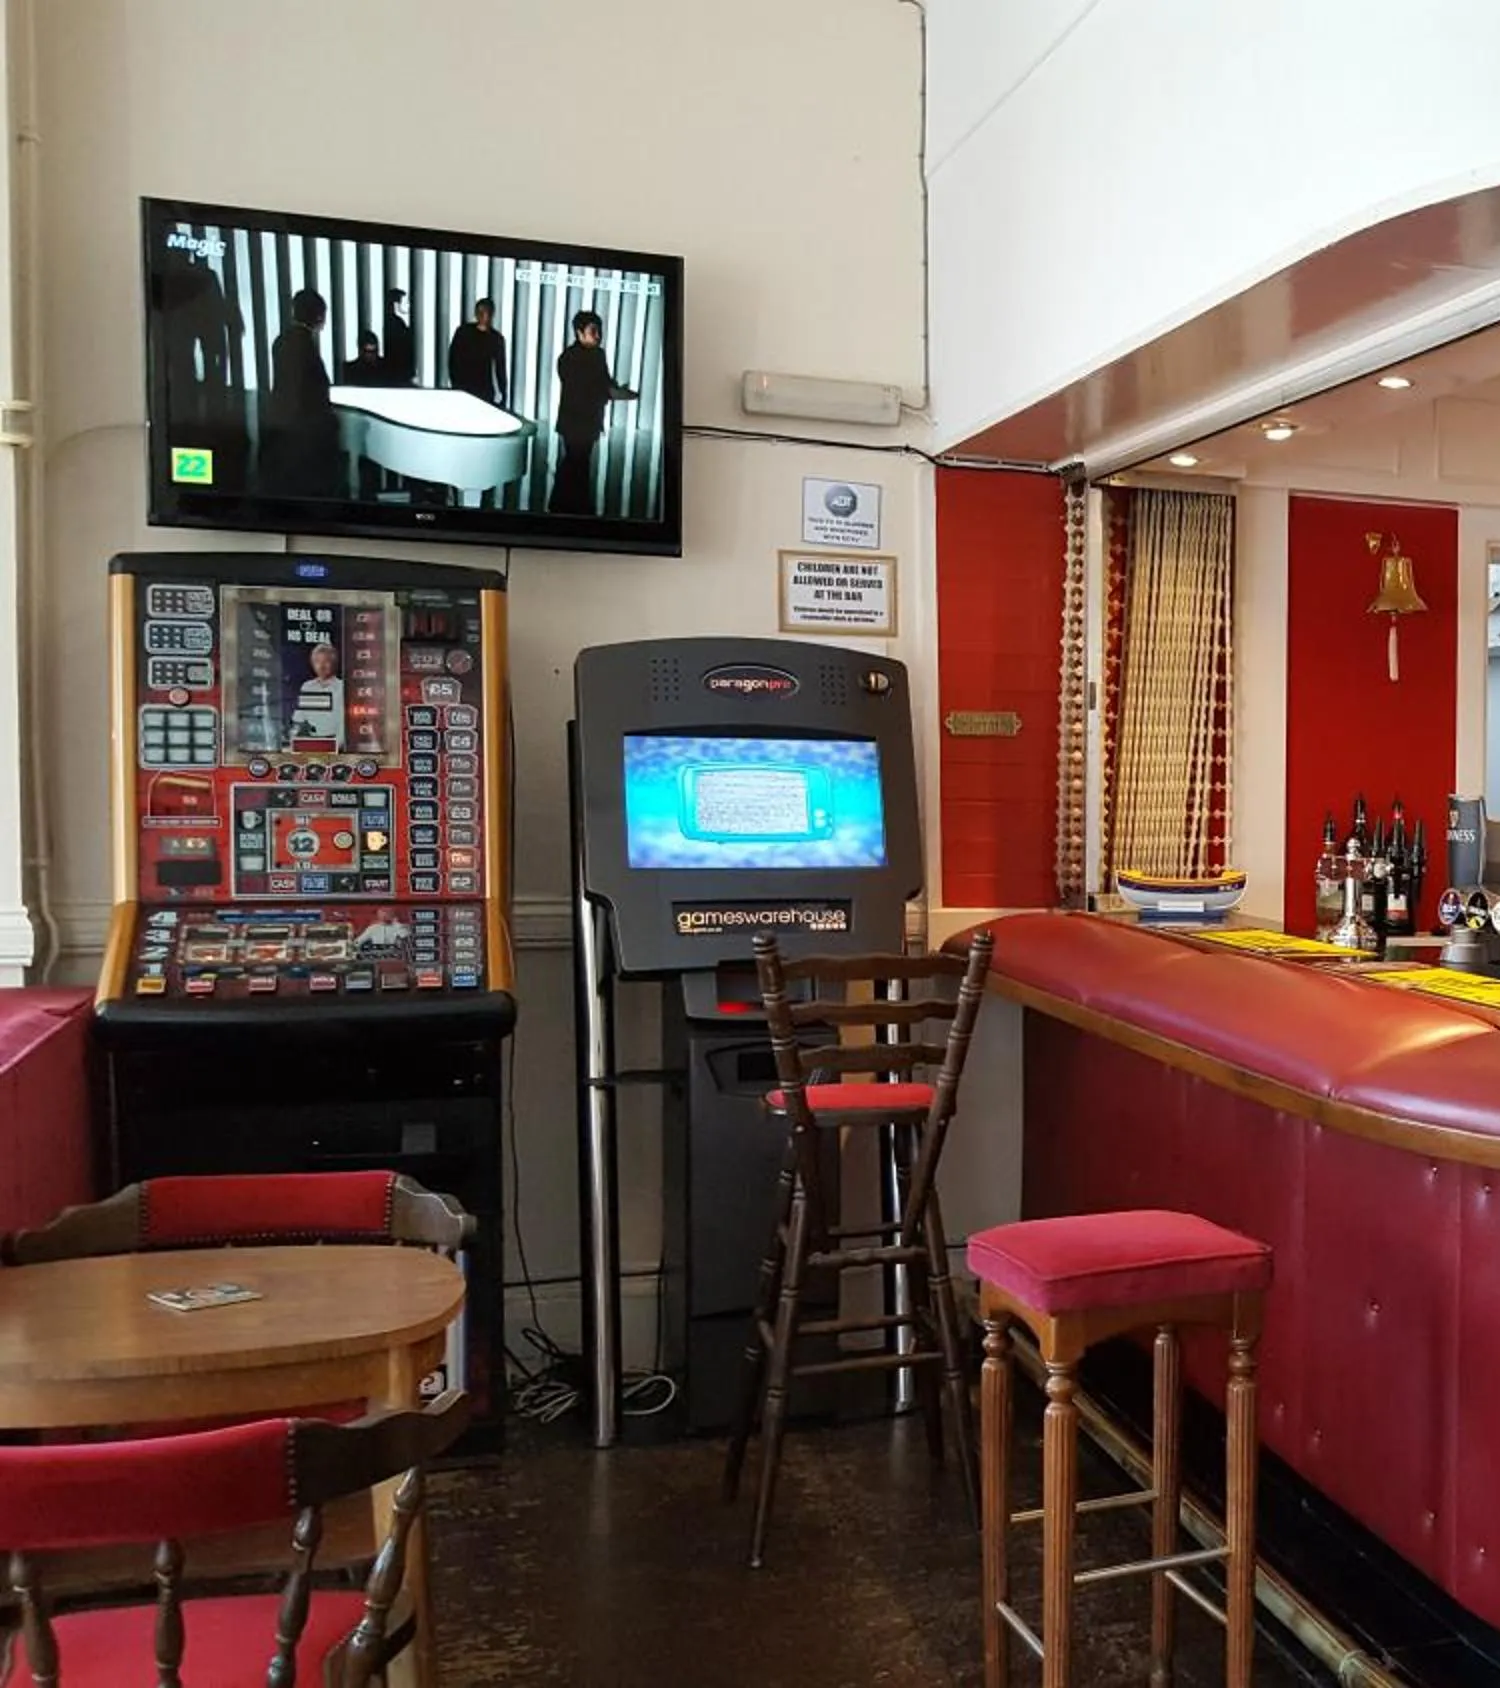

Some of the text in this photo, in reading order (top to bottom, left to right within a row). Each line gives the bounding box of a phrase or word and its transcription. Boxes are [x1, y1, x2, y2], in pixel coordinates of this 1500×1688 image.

[167, 234, 227, 257] Magic
[174, 455, 209, 479] 22
[797, 562, 878, 576] CHILDREN ARE NOT
[793, 575, 882, 589] ALLOWED OR SERVED
[814, 589, 863, 602] AT THE BAR
[287, 609, 333, 623] DEAL OR
[287, 629, 331, 644] NO DEAL
[290, 836, 315, 853] 12
[677, 908, 847, 929] gameswarehouse
